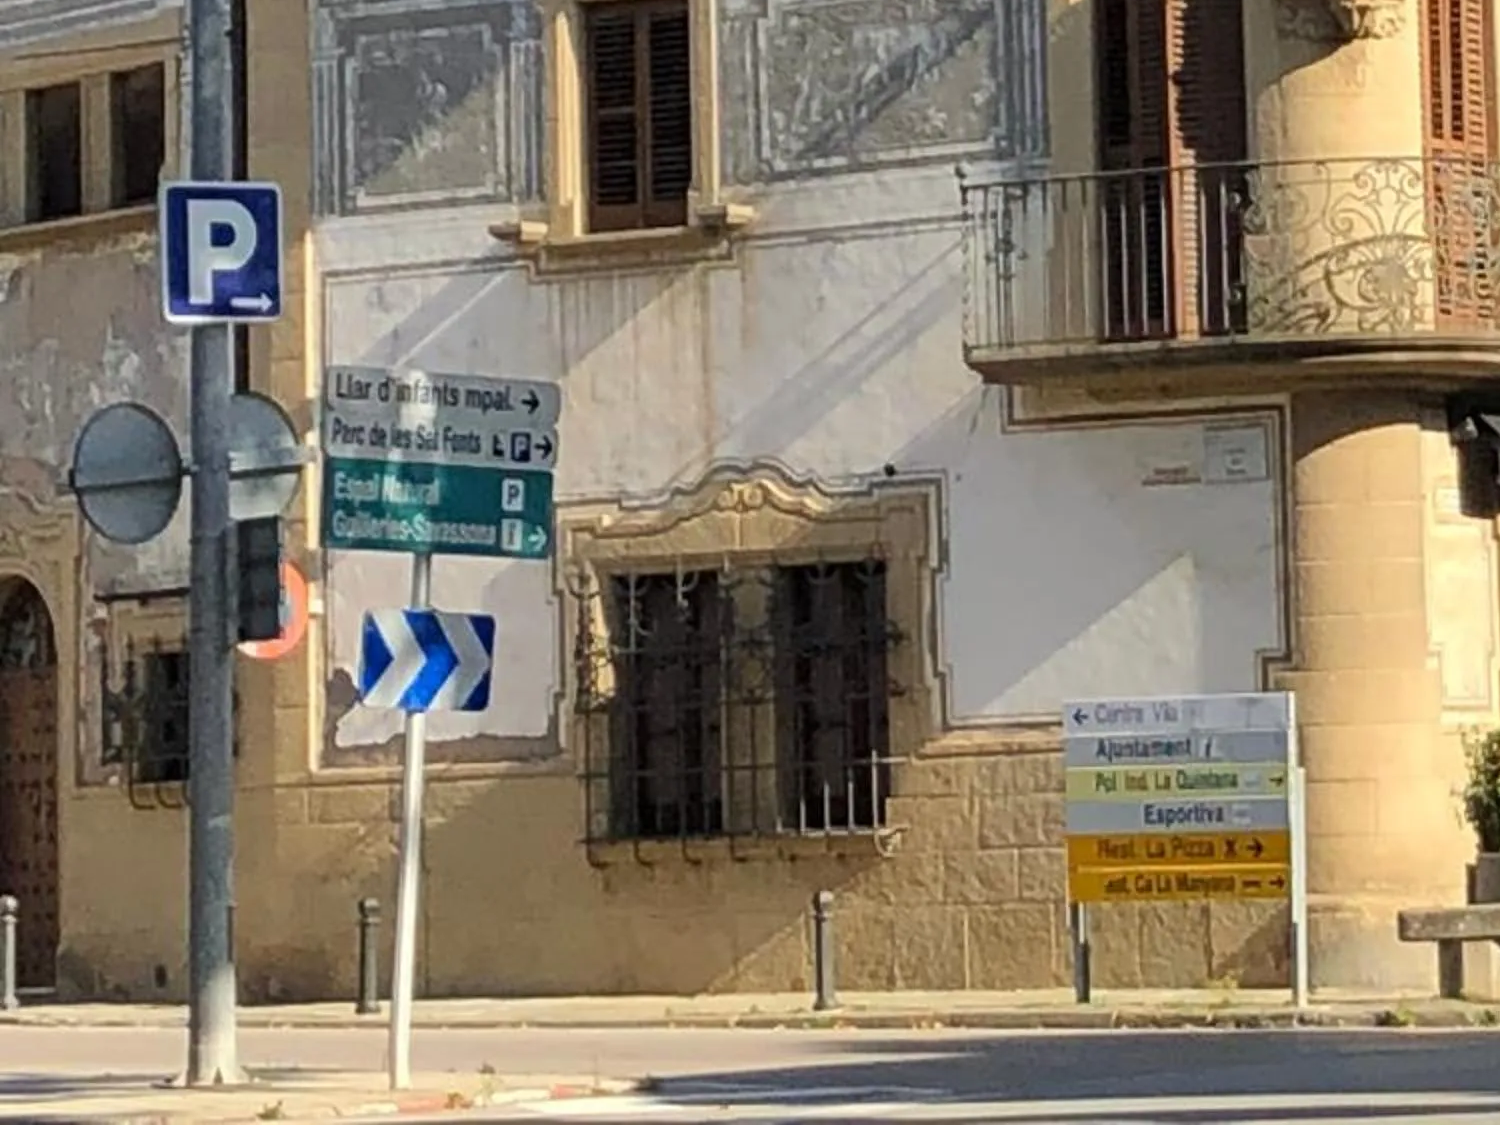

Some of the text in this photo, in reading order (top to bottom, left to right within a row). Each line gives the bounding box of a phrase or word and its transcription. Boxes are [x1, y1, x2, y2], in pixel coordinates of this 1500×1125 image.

[187, 198, 258, 306] P
[336, 373, 371, 400] Llar
[377, 376, 458, 406] d'infants
[331, 417, 366, 445] Parc
[368, 420, 387, 447] de
[1096, 737, 1192, 763] Ajuntament
[1143, 804, 1225, 828] Esportiva
